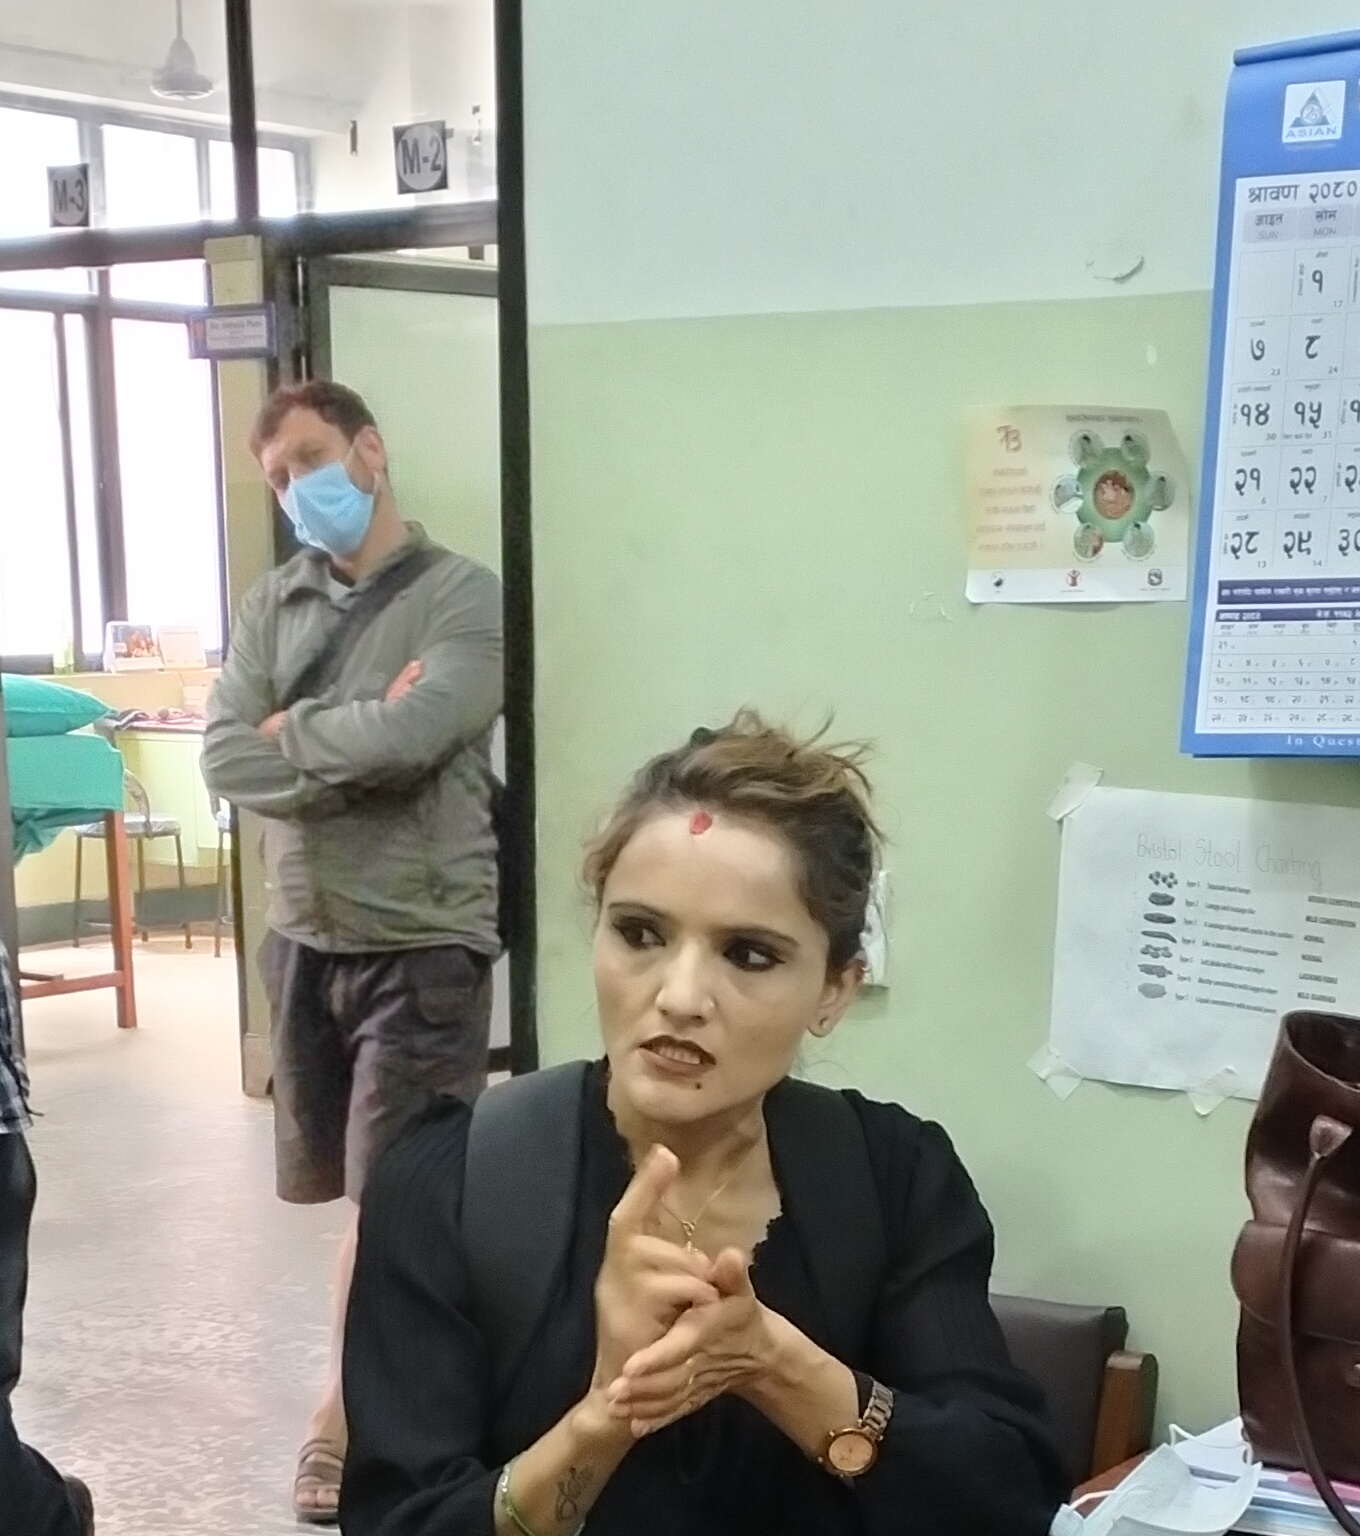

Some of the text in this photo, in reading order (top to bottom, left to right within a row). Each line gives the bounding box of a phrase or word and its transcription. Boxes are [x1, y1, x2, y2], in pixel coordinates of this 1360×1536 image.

[1286, 127, 1337, 138] ASIAN
[401, 135, 442, 174] M-2
[1248, 180, 1358, 203] श्रावण २०८०
[1312, 269, 1323, 293] १
[1250, 338, 1266, 361] ७
[1305, 335, 1321, 359] ८
[1240, 402, 1270, 427] १४
[1294, 401, 1322, 429] १५
[1235, 467, 1261, 497] २१
[1290, 466, 1317, 495] २२
[1230, 531, 1260, 560] २८
[1283, 530, 1312, 559] २९
